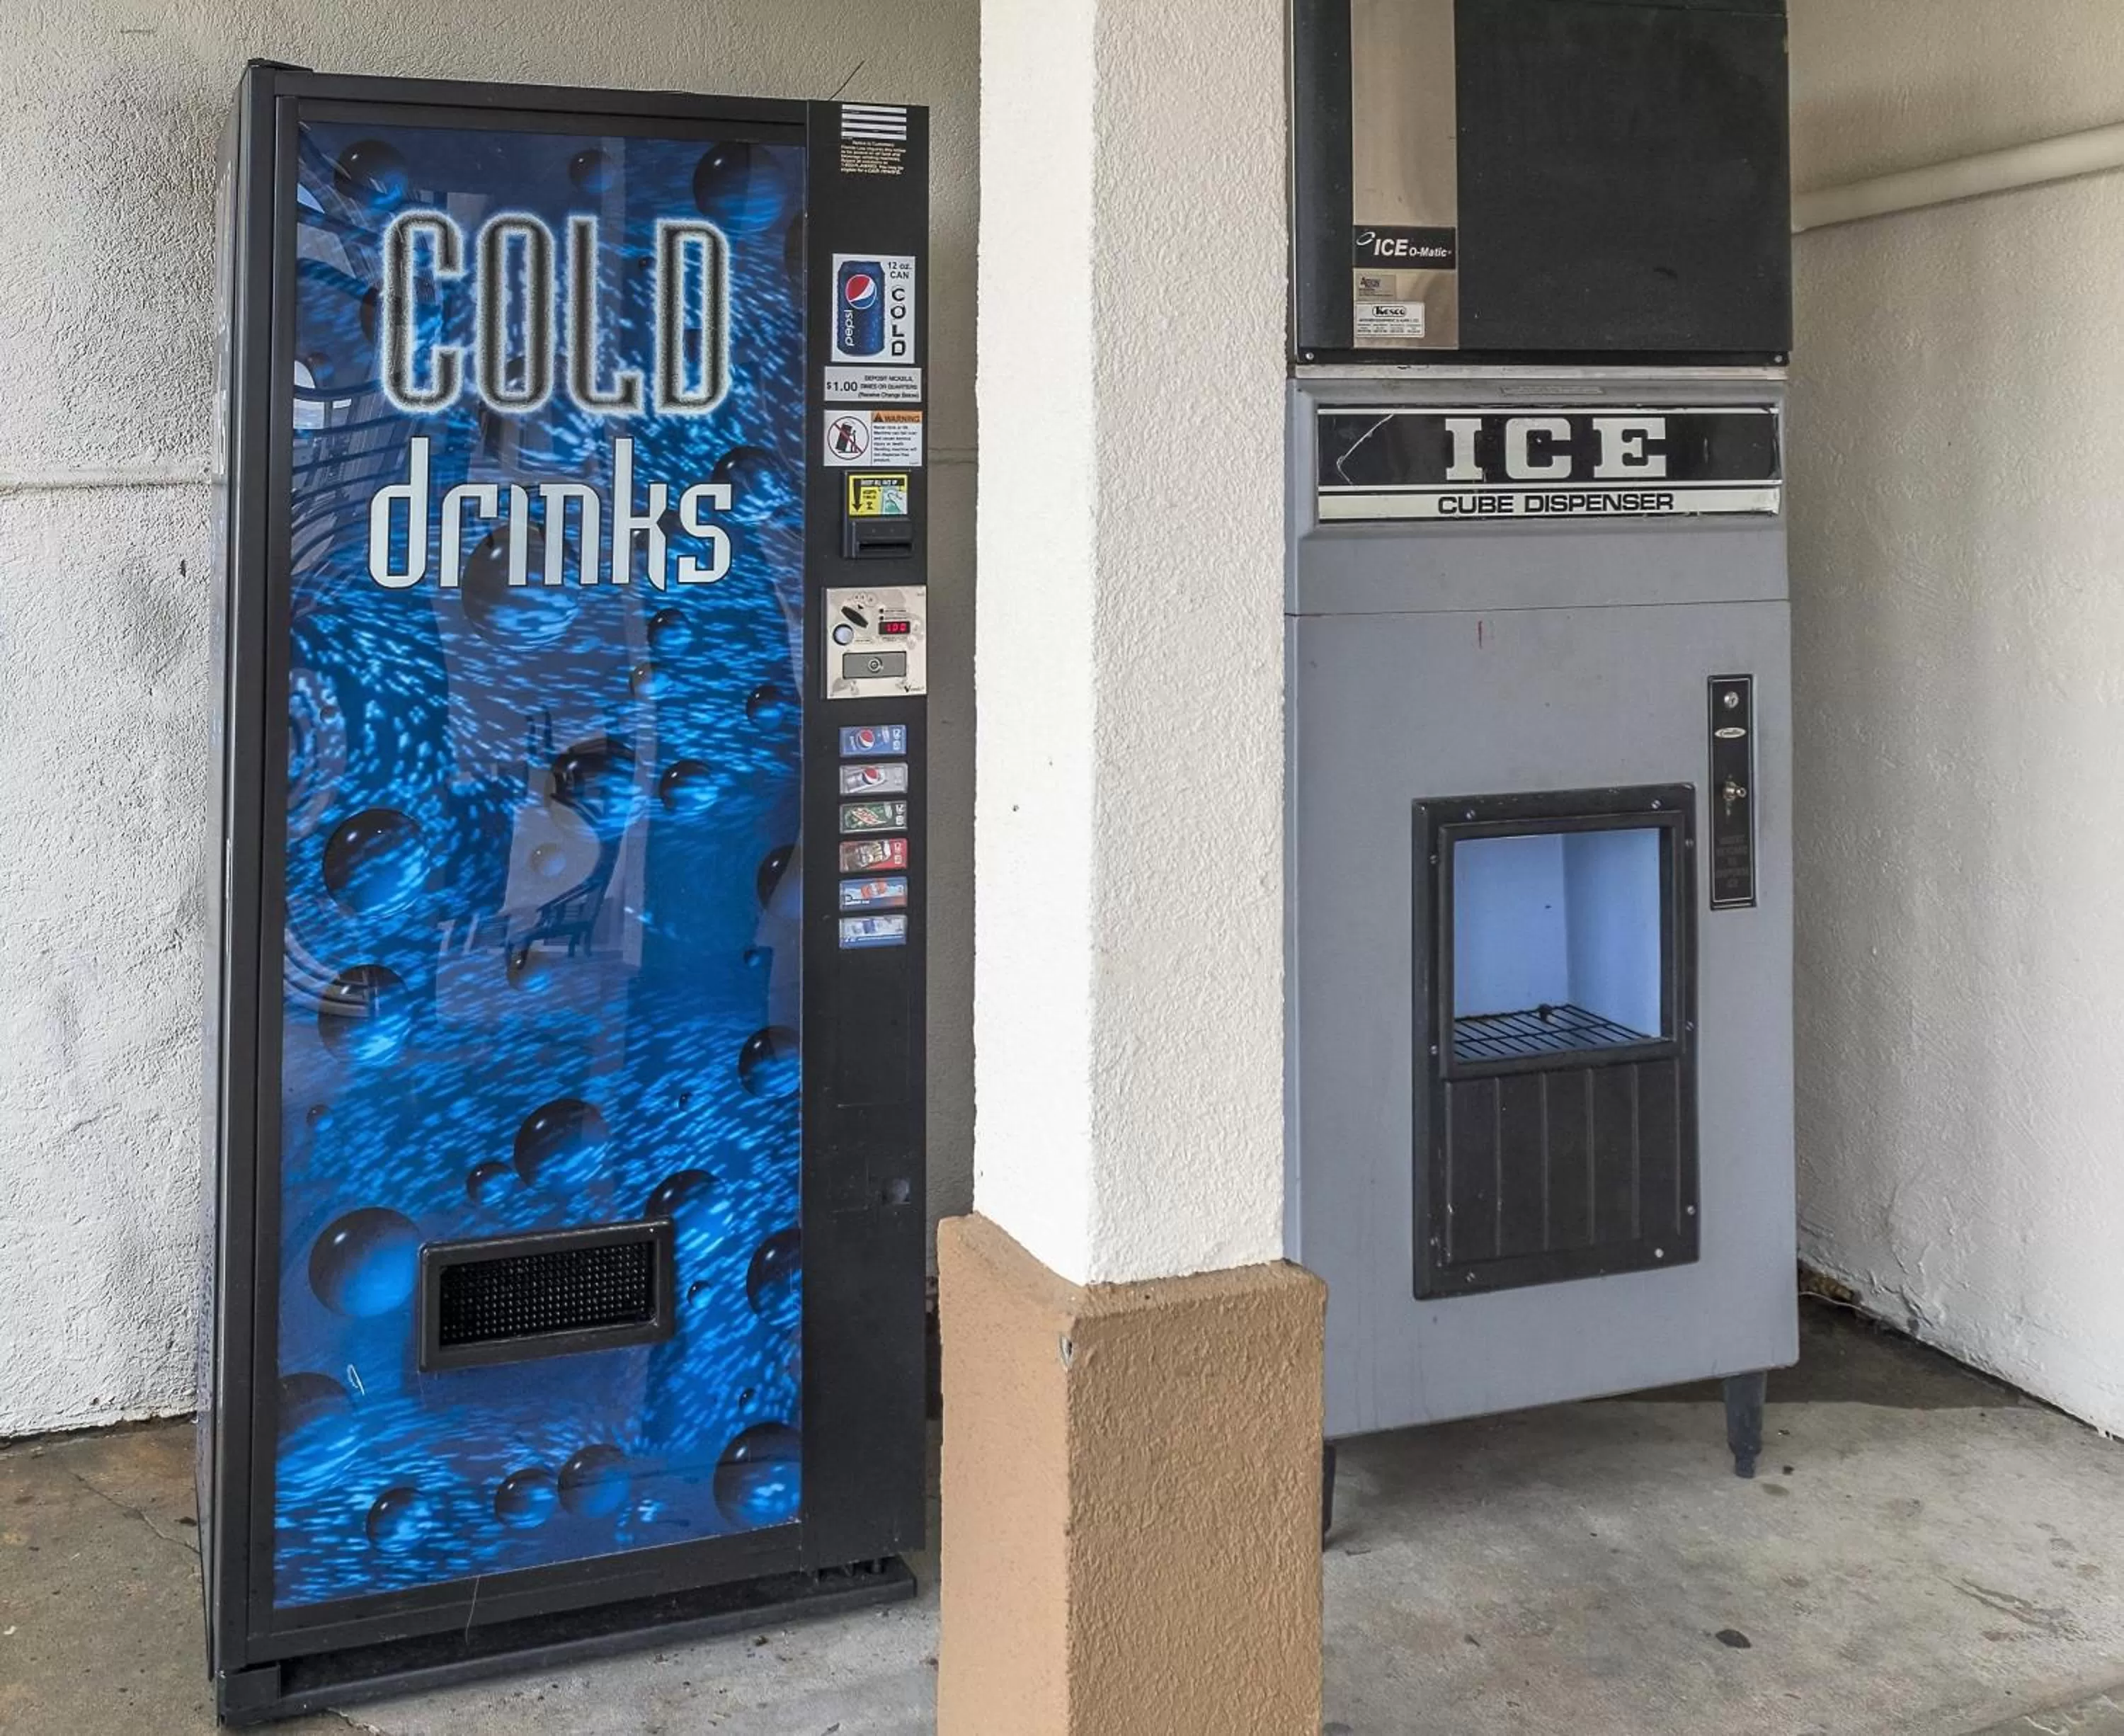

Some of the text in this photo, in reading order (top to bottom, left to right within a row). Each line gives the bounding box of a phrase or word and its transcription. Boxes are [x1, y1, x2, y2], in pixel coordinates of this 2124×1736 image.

[1374, 239, 1408, 256] ICE
[383, 210, 730, 415] COLD
[844, 309, 855, 346] pepsi
[891, 288, 906, 356] COLD
[1445, 417, 1667, 481] ICE
[370, 437, 731, 590] drinks
[1438, 493, 1674, 515] CUBE DISPENSER
